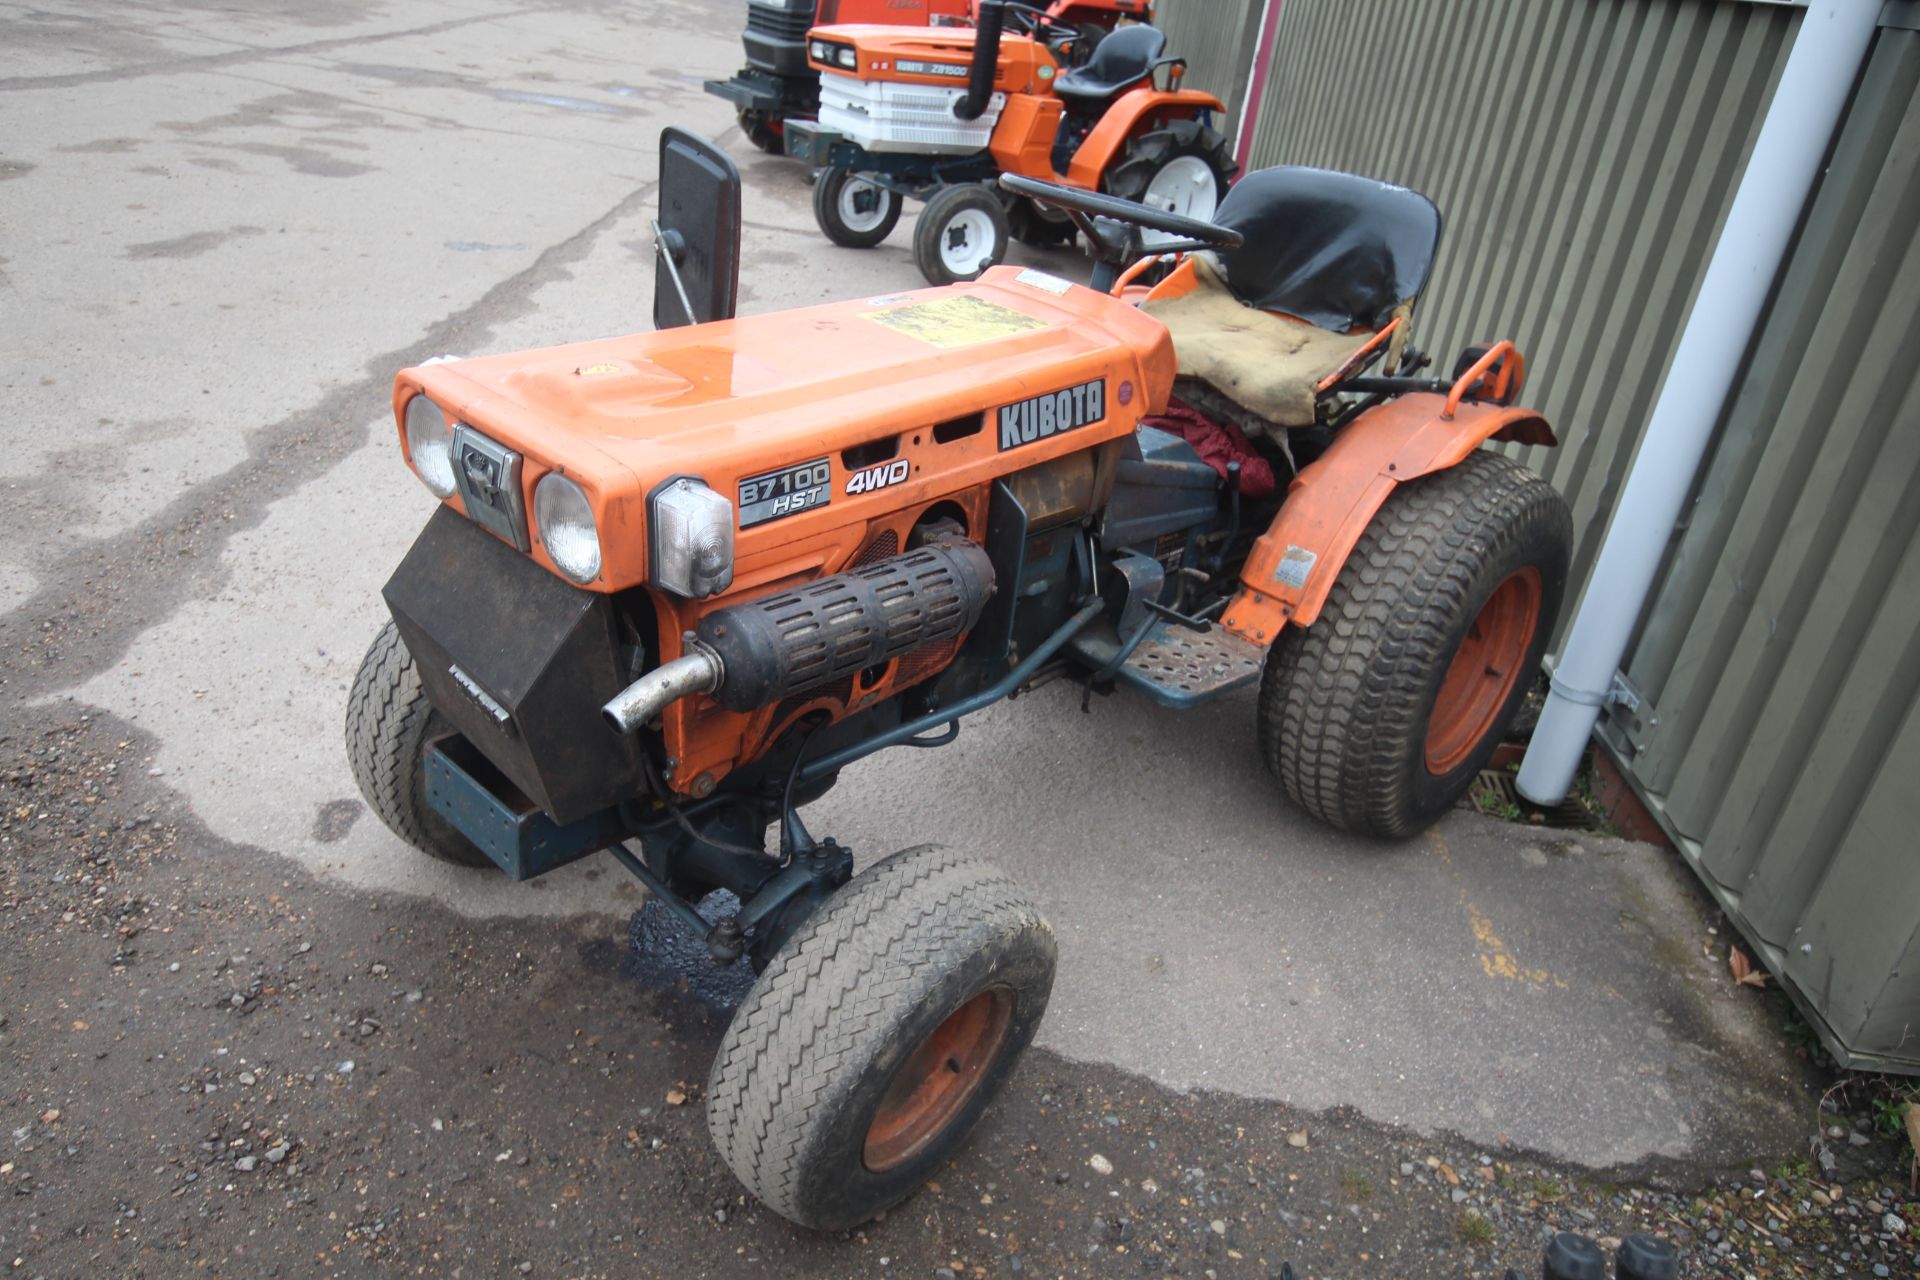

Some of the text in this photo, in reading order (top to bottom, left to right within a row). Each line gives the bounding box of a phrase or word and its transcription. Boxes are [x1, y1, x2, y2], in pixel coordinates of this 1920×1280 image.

[1001, 380, 1102, 449] KUBOTA
[743, 463, 830, 502] B7100
[845, 459, 909, 496] 4WD
[771, 487, 823, 516] HST
